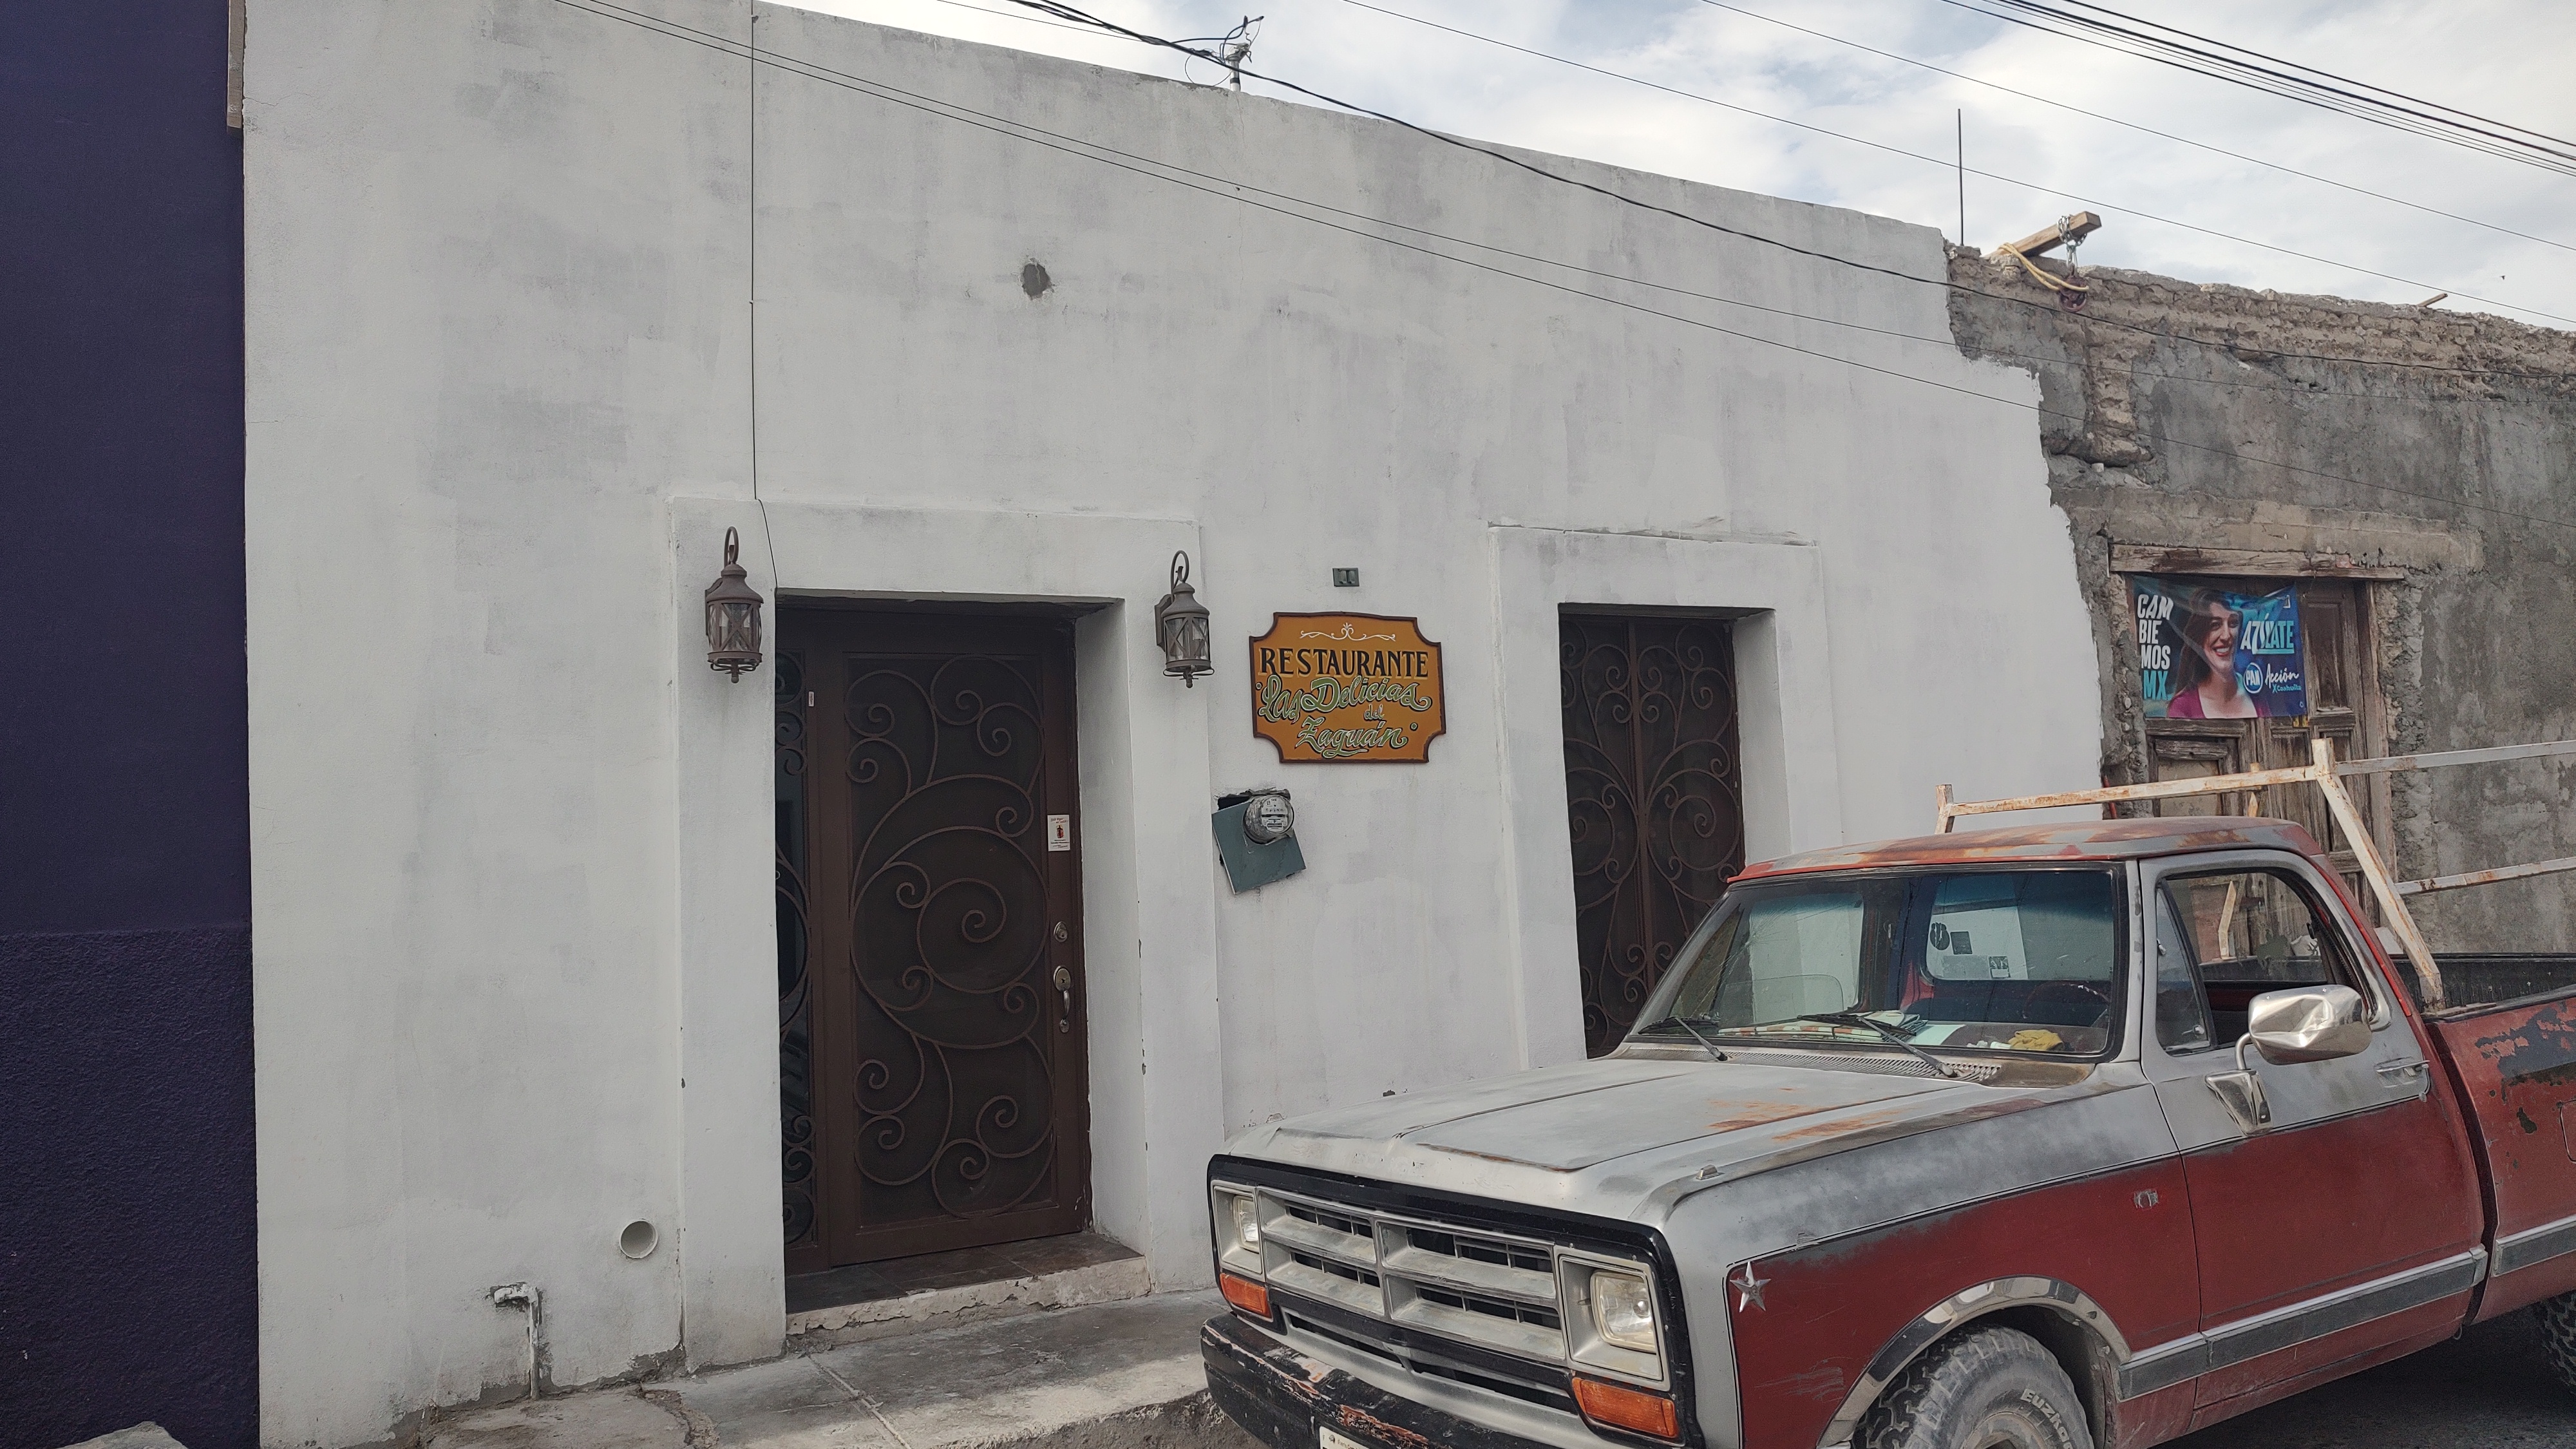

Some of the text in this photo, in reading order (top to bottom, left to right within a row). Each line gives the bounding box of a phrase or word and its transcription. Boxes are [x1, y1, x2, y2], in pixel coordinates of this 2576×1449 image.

[2137, 594, 2174, 621] CAM
[2139, 619, 2163, 645] BIE
[1259, 647, 1428, 678] RESTAURANTE
[2141, 645, 2171, 670] MOS
[2246, 669, 2260, 686] PAN
[2265, 663, 2299, 688] Acción
[1258, 674, 1433, 724] Las Delicias
[1363, 704, 1384, 721] del
[1295, 716, 1409, 759] Zaguán
